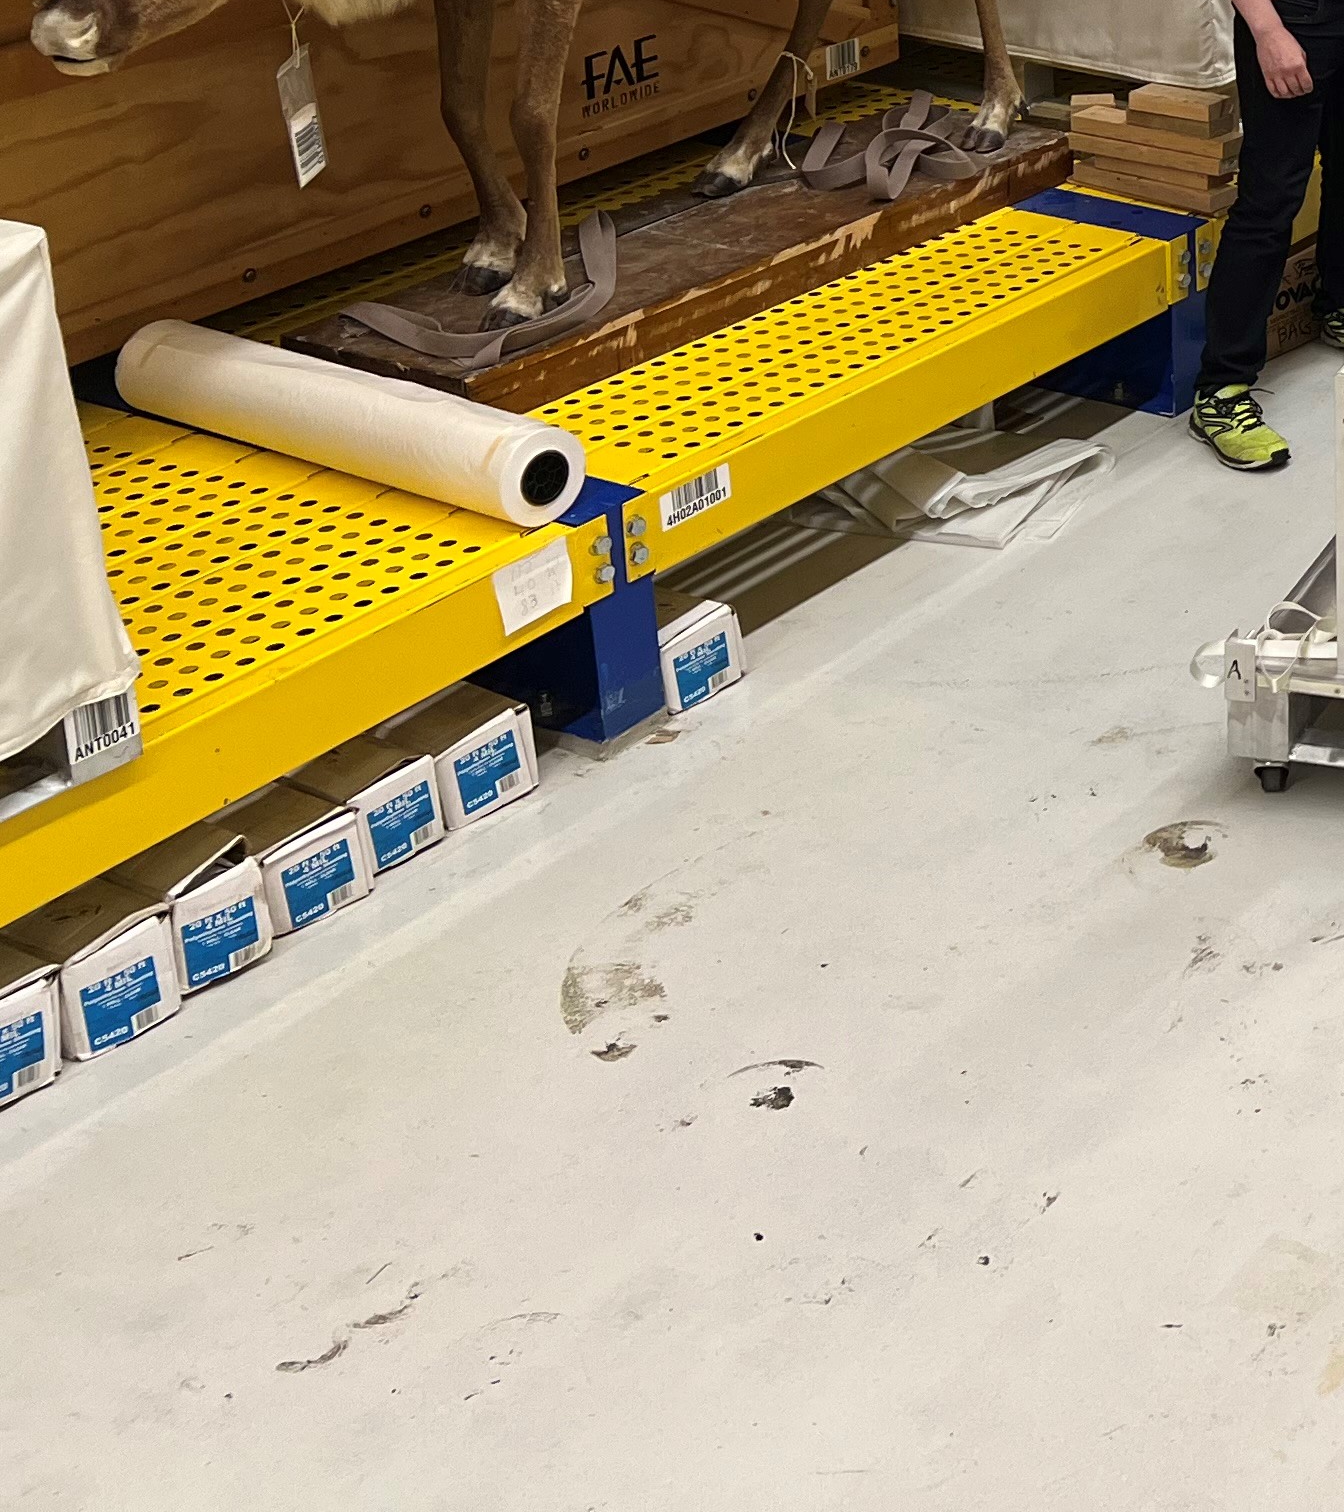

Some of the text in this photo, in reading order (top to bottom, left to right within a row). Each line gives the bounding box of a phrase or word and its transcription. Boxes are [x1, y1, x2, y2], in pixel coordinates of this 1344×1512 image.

[581, 34, 659, 100] FAE
[582, 82, 660, 119] WORLDWIDE
[667, 487, 728, 526] 4H02A01001
[1227, 659, 1242, 680] A
[75, 722, 135, 762] ANT0041
